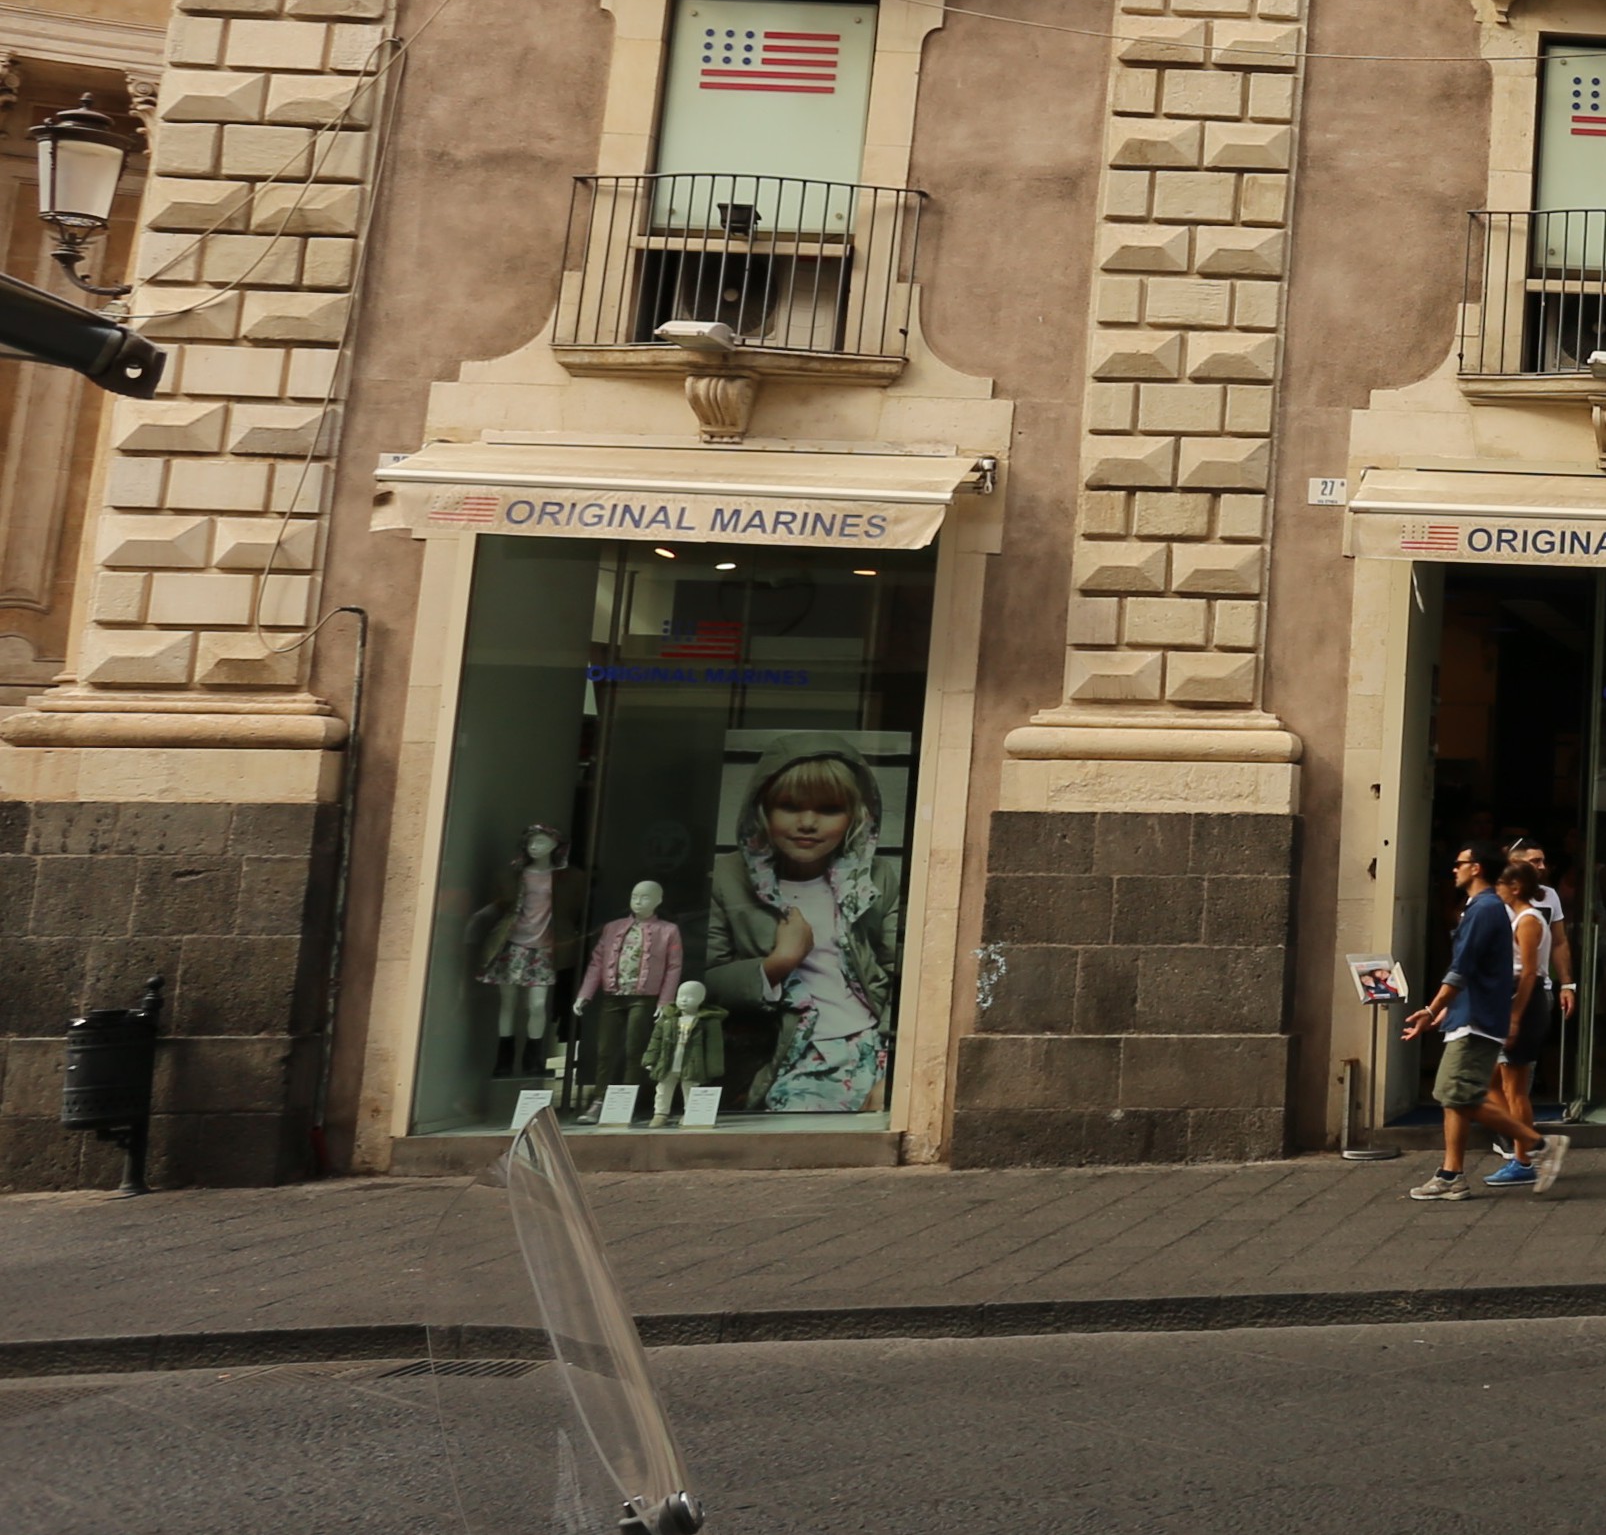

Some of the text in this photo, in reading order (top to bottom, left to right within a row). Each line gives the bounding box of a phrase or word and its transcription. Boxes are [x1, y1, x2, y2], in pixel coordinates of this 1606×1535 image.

[1321, 480, 1335, 496] 27
[504, 499, 887, 539] ORIGINAL MARINES
[586, 666, 810, 686] ORIGINAL MARINES
